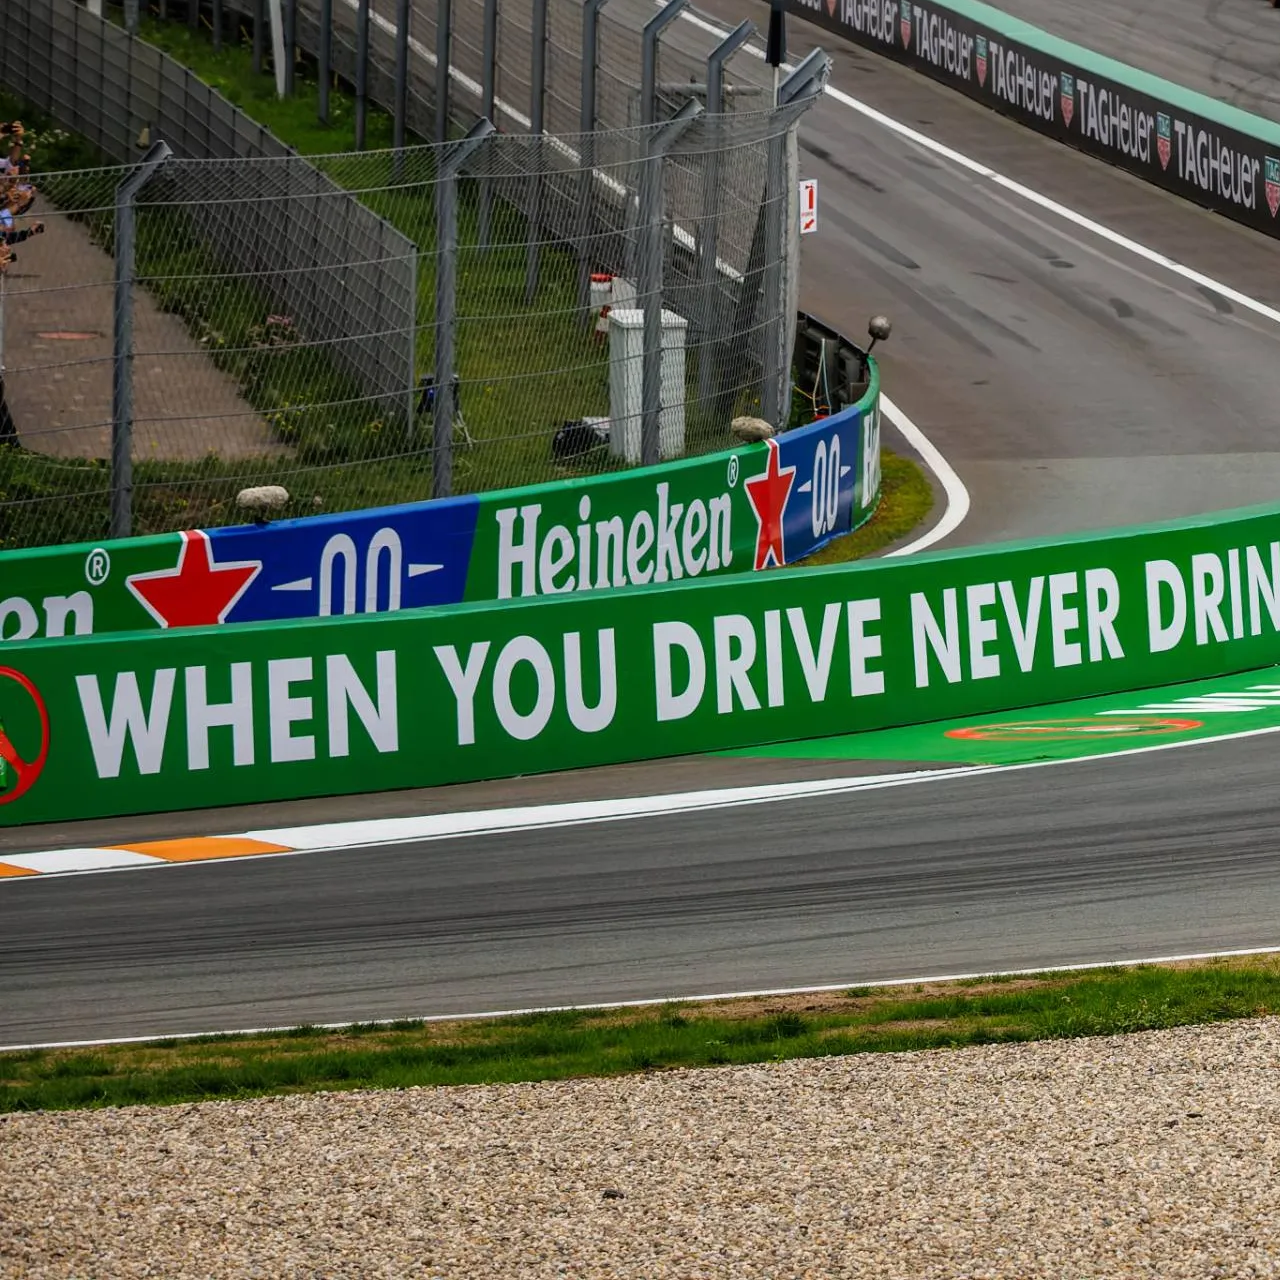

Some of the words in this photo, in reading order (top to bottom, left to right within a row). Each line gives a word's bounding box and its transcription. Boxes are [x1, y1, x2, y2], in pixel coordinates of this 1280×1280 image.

[1157, 113, 1171, 137] TAG
[1265, 158, 1280, 181] TAG
[811, 433, 841, 538] 0.0
[75, 649, 399, 779] WHEN
[432, 627, 618, 746] YOU
[653, 598, 886, 723] DRIVE
[910, 567, 1125, 688] NEVER
